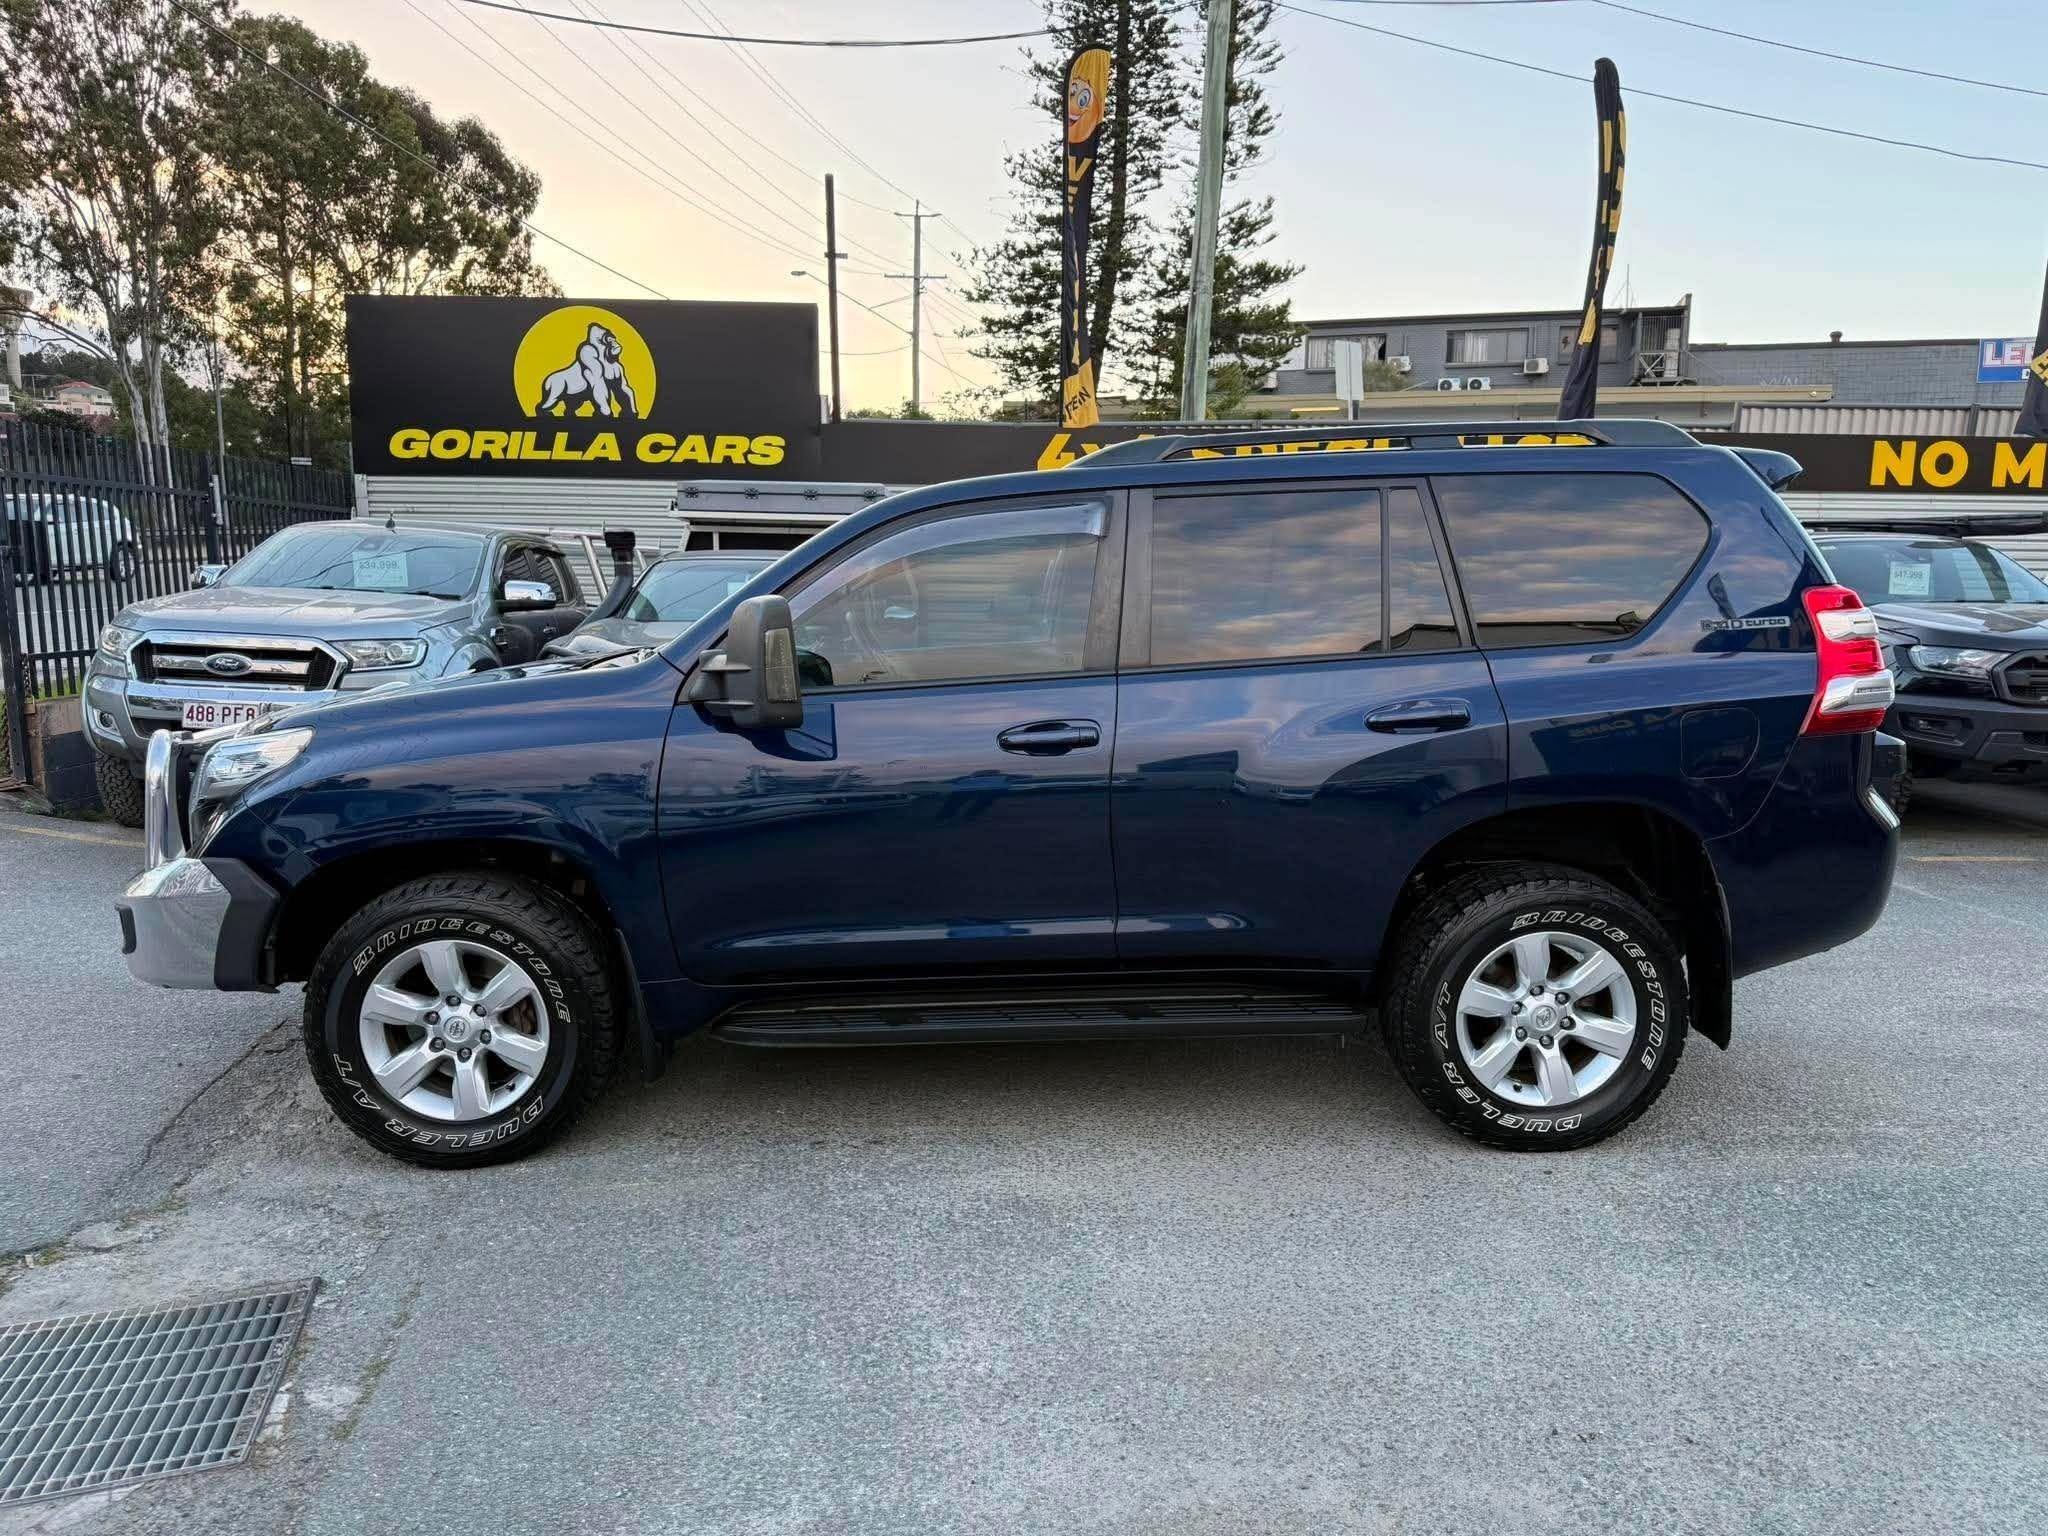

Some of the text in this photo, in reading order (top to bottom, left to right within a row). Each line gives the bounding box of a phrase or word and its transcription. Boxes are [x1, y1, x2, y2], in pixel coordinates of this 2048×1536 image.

[389, 428, 786, 466] GORILLA CARS
[1870, 440, 1968, 488] NO
[352, 918, 571, 1024] BRIDGESTONE
[1510, 910, 1666, 1071] BRIDGESTONE
[333, 1053, 545, 1148] DUELER A/T
[1434, 981, 1583, 1132] DUELER A/T
